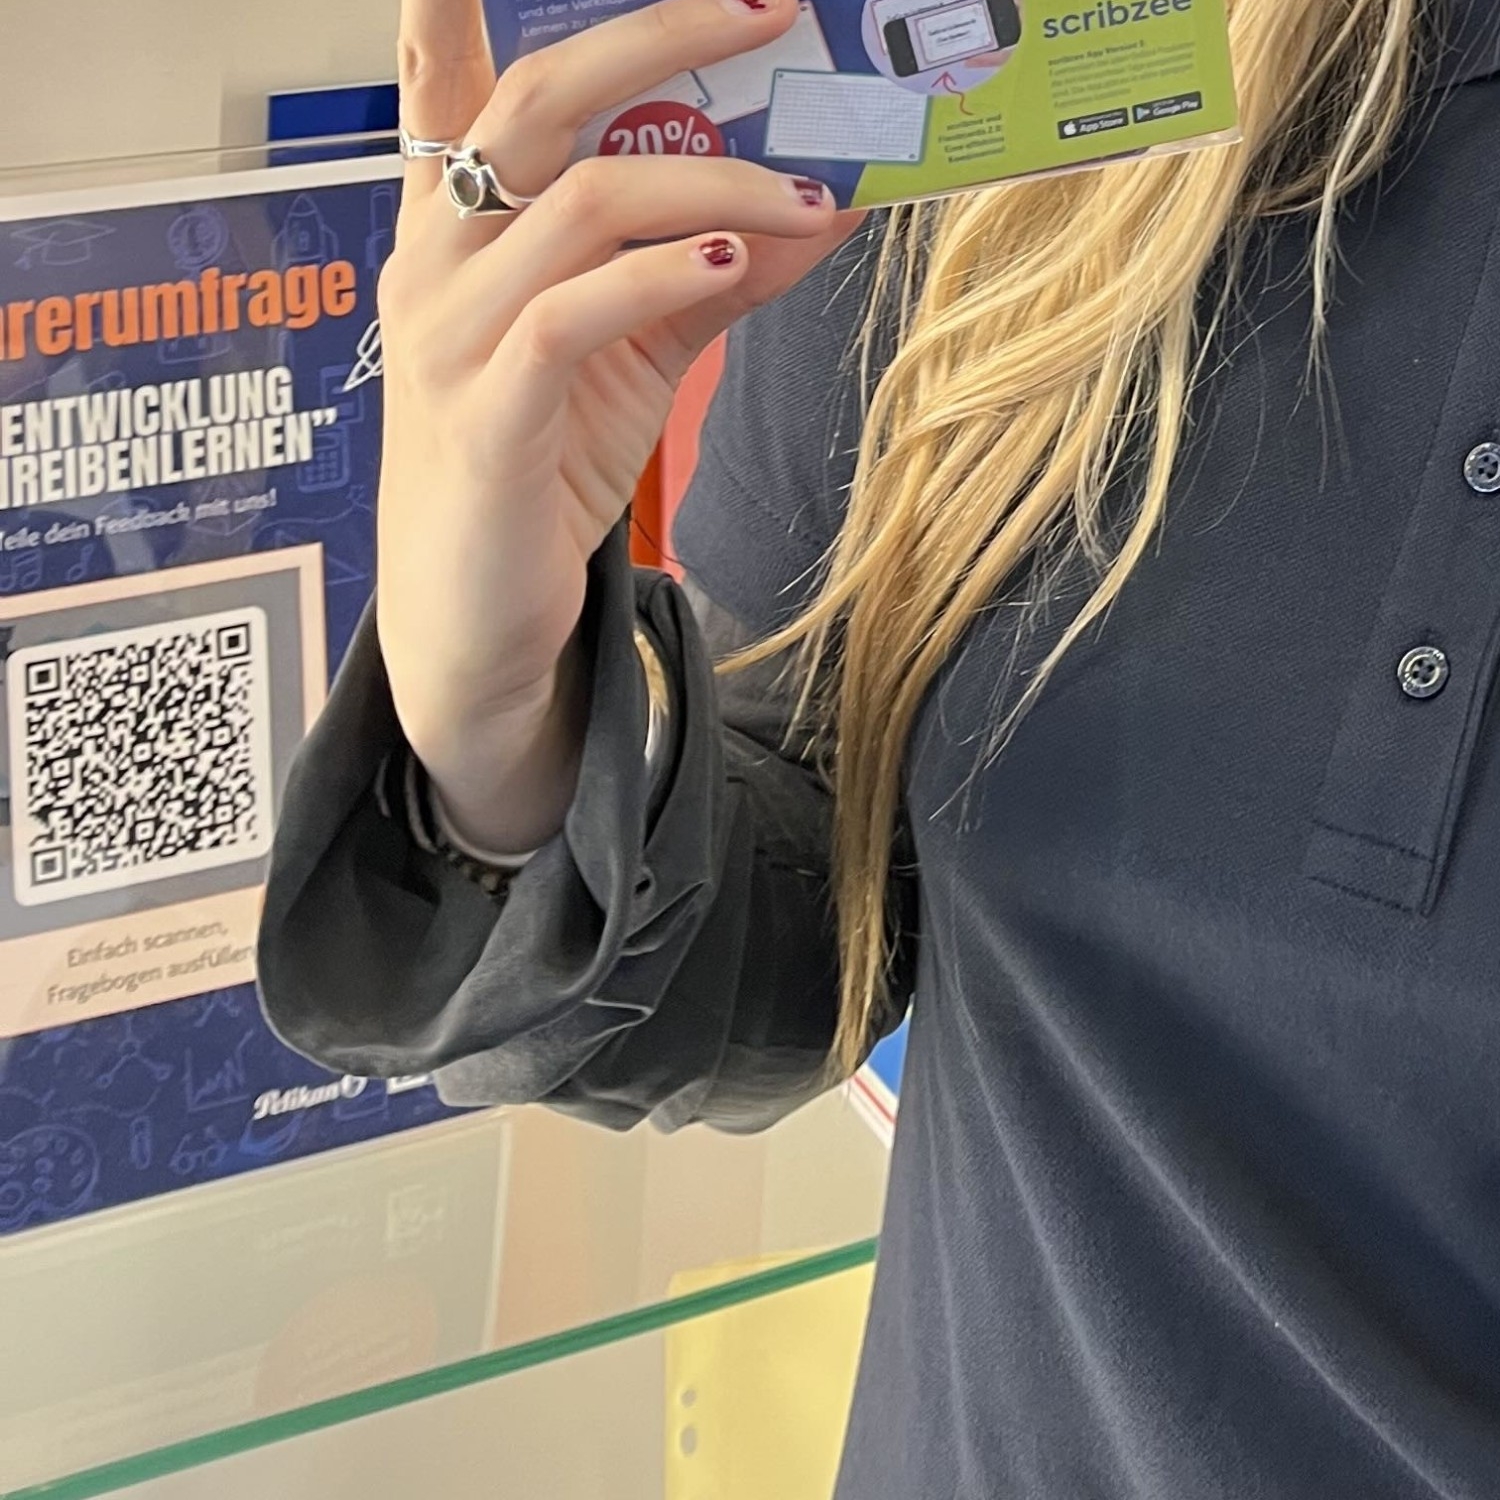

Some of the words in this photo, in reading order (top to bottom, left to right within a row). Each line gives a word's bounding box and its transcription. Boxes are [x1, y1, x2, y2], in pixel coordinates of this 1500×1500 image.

[609, 116, 711, 156] 20%
[0, 260, 356, 360] rerumfrage
[0, 528, 40, 550] eile
[44, 523, 90, 545] dein
[94, 501, 190, 535] Feedback
[195, 500, 230, 519] mit
[234, 488, 277, 513] uns!
[67, 933, 138, 968] Einfach
[143, 921, 228, 950] scannen,
[47, 968, 163, 1004] Fragebogen
